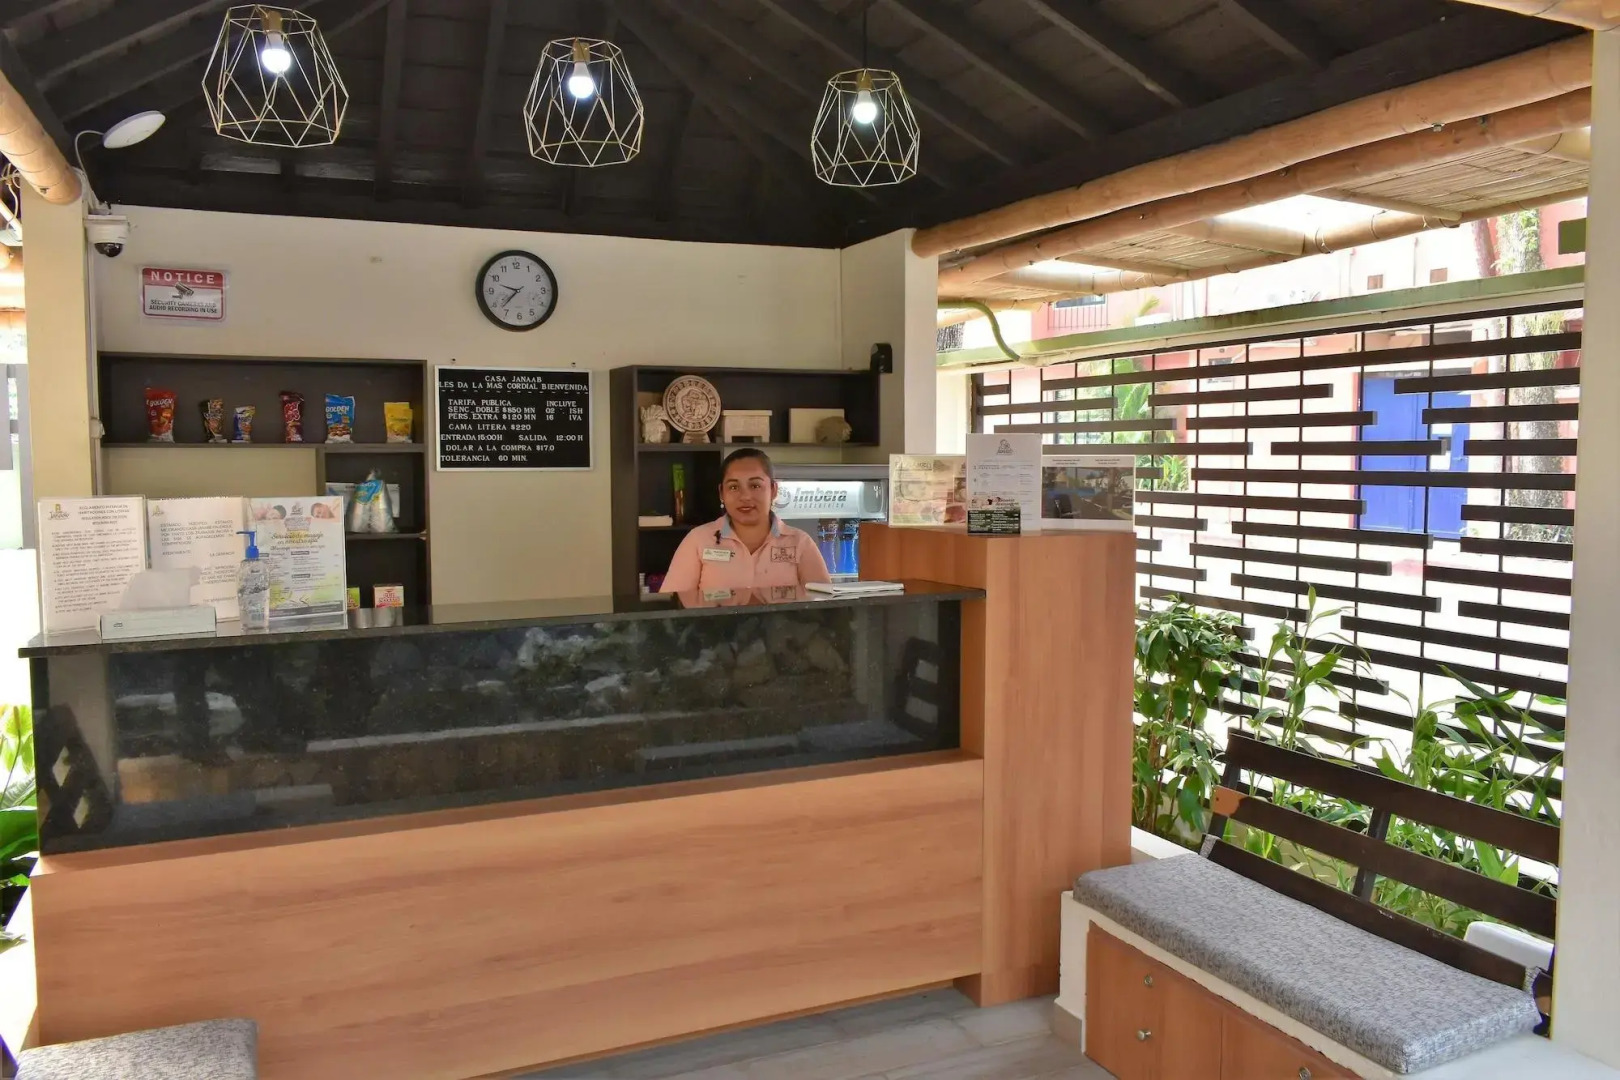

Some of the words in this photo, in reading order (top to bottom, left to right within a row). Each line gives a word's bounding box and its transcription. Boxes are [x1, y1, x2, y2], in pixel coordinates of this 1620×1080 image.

[150, 271, 214, 284] NOTICE
[150, 399, 173, 407] GOLDEN
[793, 488, 847, 502] Imbera
